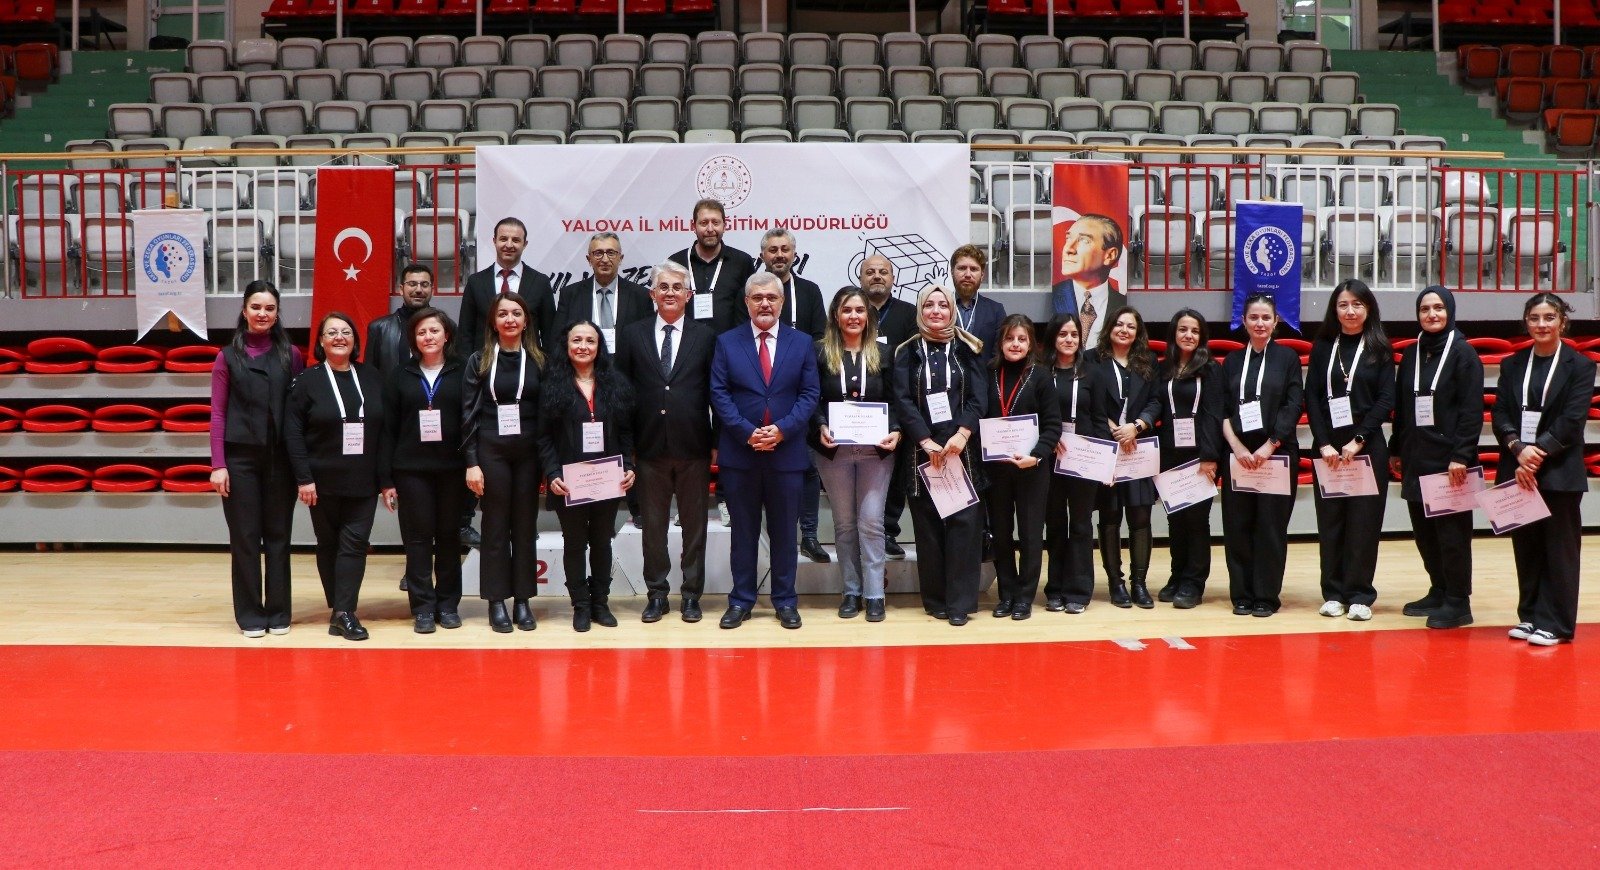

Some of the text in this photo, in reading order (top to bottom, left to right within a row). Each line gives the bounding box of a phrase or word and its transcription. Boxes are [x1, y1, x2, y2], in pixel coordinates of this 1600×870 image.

[561, 213, 888, 232] YALOVA İL MİLL ĞİTİM MÜDÜRLÜĞÜ
[536, 559, 548, 584] 2
